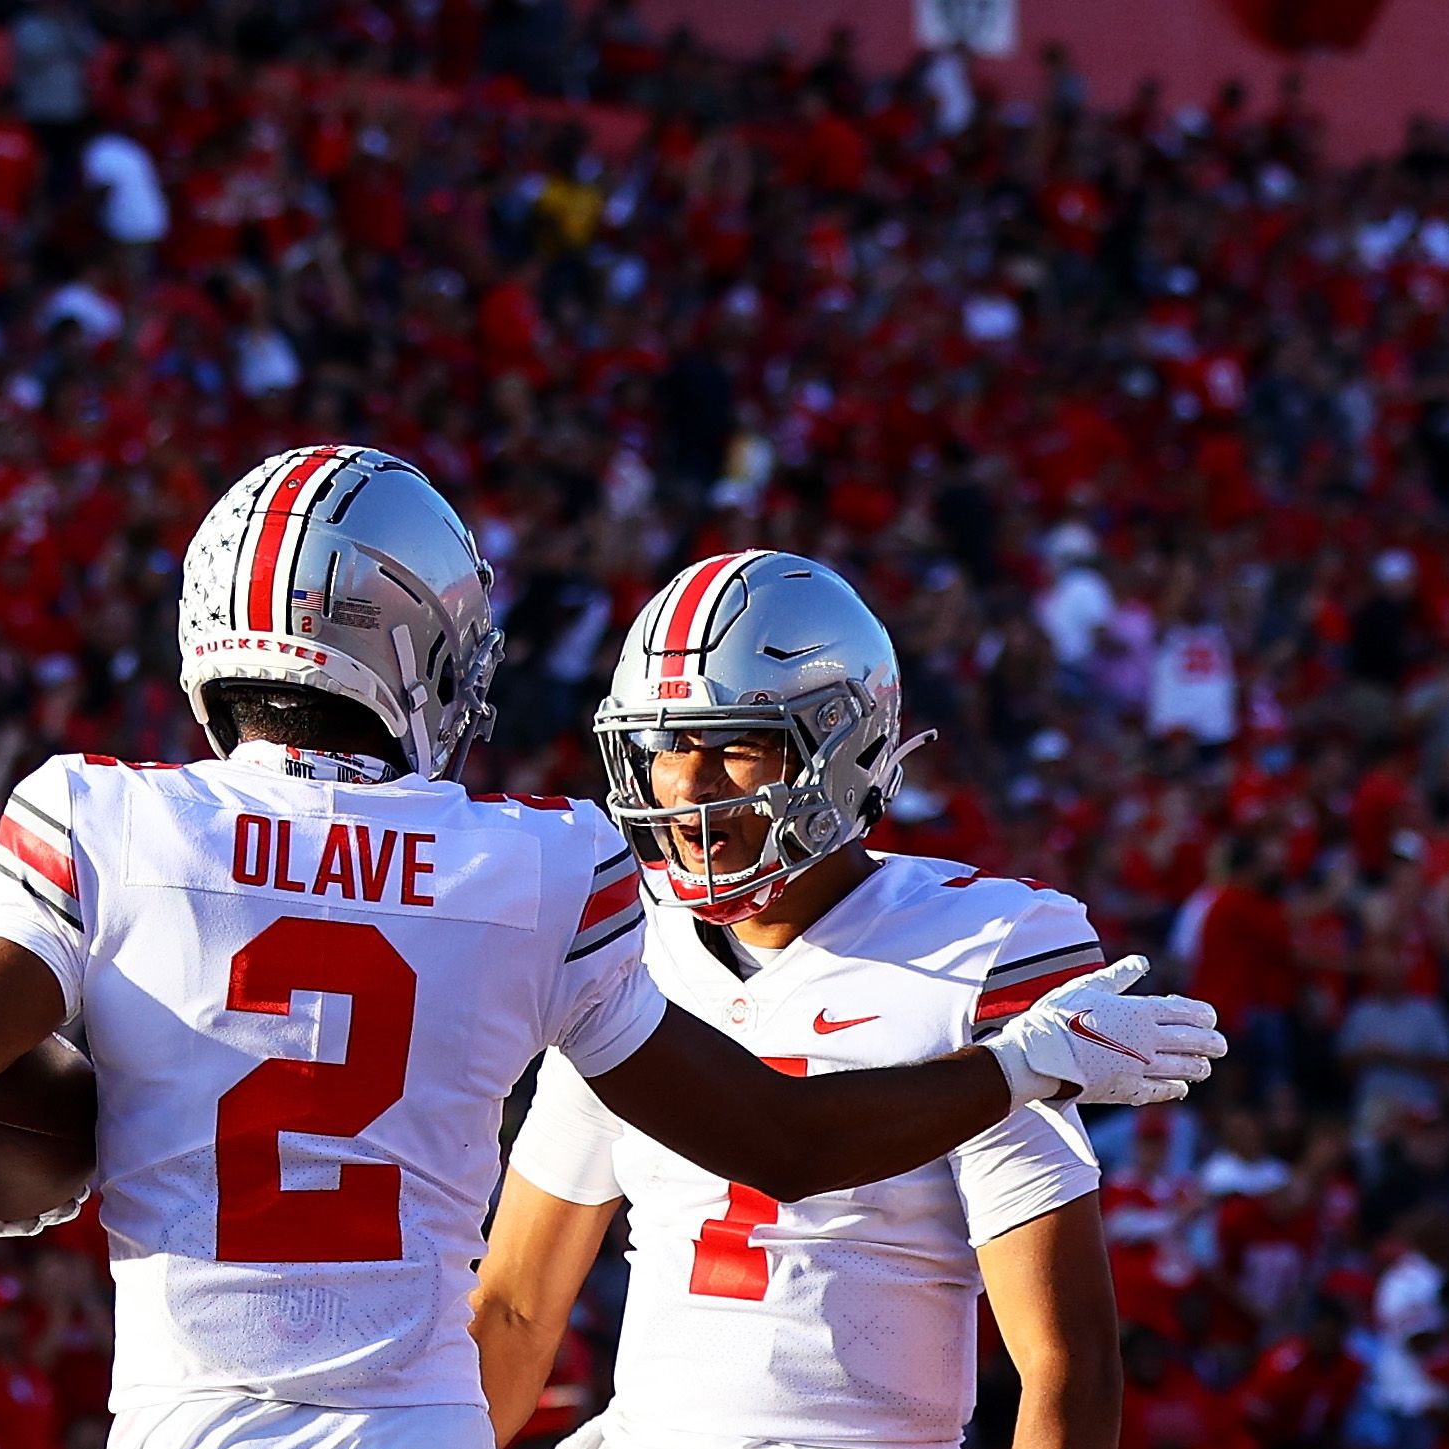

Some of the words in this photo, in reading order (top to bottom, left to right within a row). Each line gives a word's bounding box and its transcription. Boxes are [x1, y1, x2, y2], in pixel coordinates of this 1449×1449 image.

[195, 638, 328, 666] BUCKEYES
[301, 616, 312, 633] 2
[232, 813, 436, 907] OLAVE
[215, 915, 418, 1262] 2
